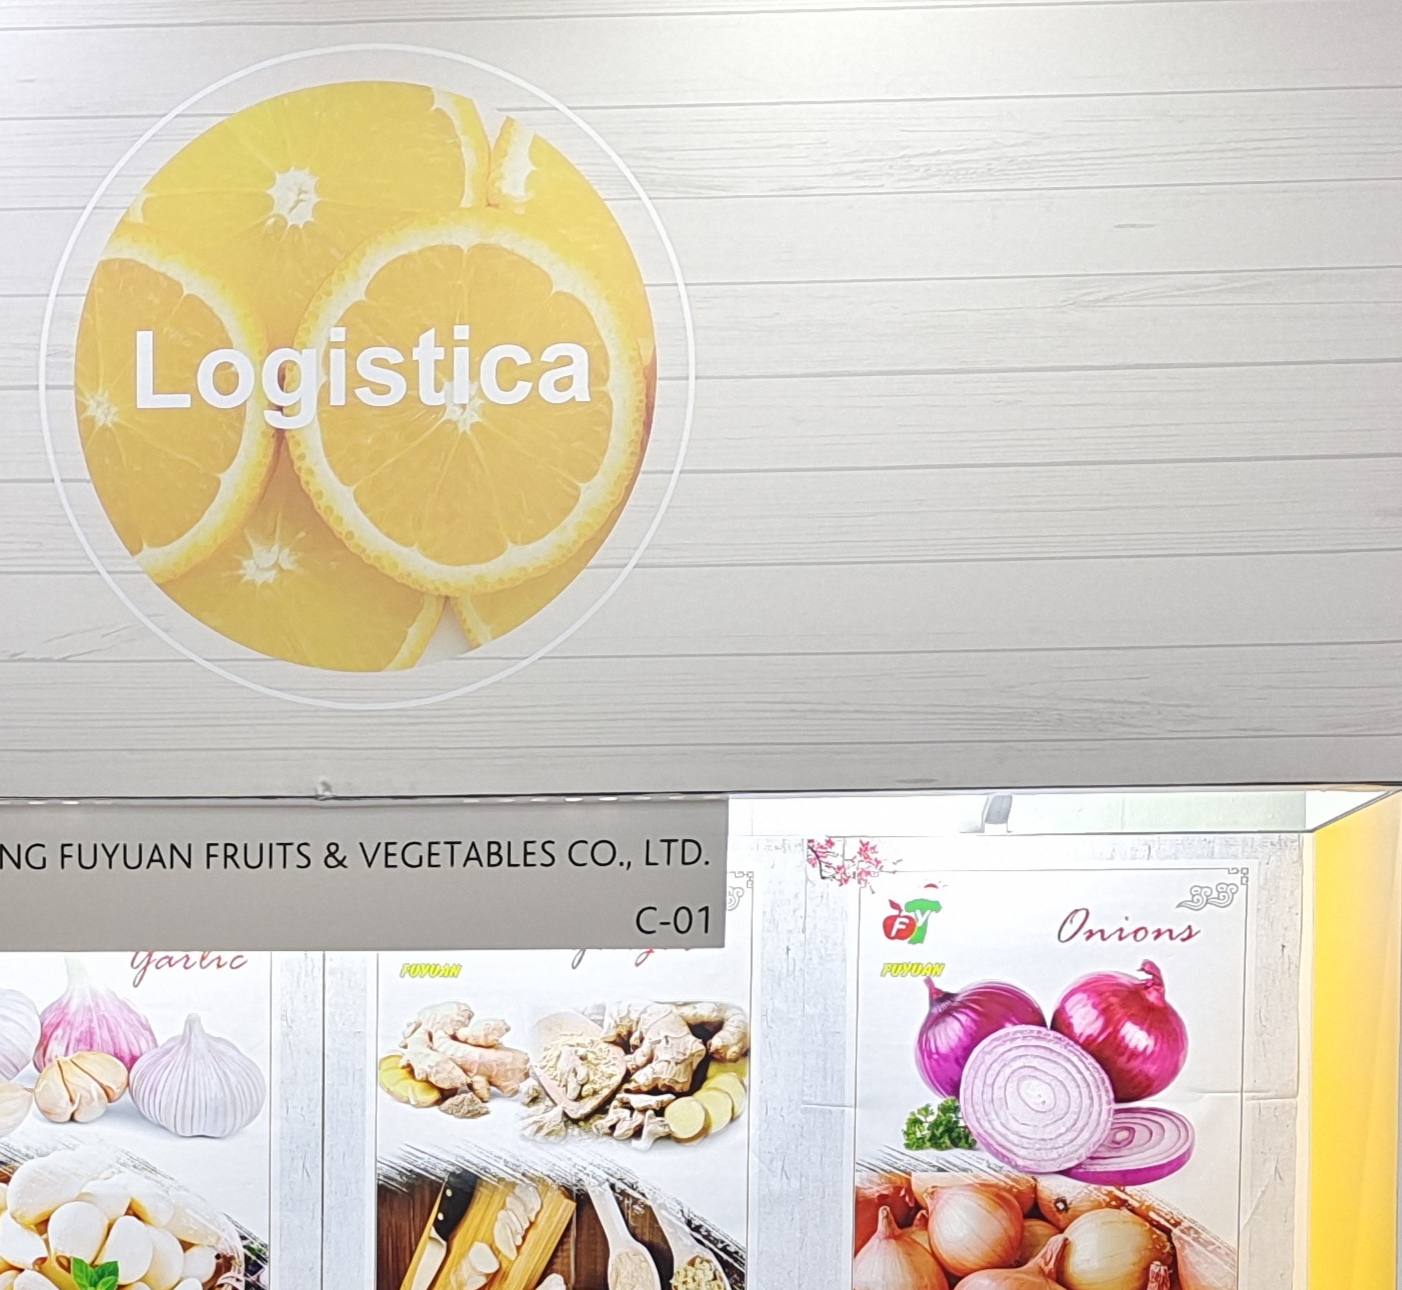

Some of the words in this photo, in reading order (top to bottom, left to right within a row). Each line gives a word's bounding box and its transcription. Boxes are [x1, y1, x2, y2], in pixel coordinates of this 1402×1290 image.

[136, 324, 591, 429] Logistica
[60, 842, 192, 870] FUYUAN
[206, 841, 312, 870] FRUITS
[323, 842, 348, 869] &
[359, 840, 555, 869] VEGETABLES
[568, 839, 631, 871] CO.,
[646, 838, 710, 867] LTD.
[635, 906, 711, 934] C-01
[1057, 907, 1201, 943] Onions
[399, 963, 462, 978] FUYUAN
[880, 962, 946, 978] FUYUAN
